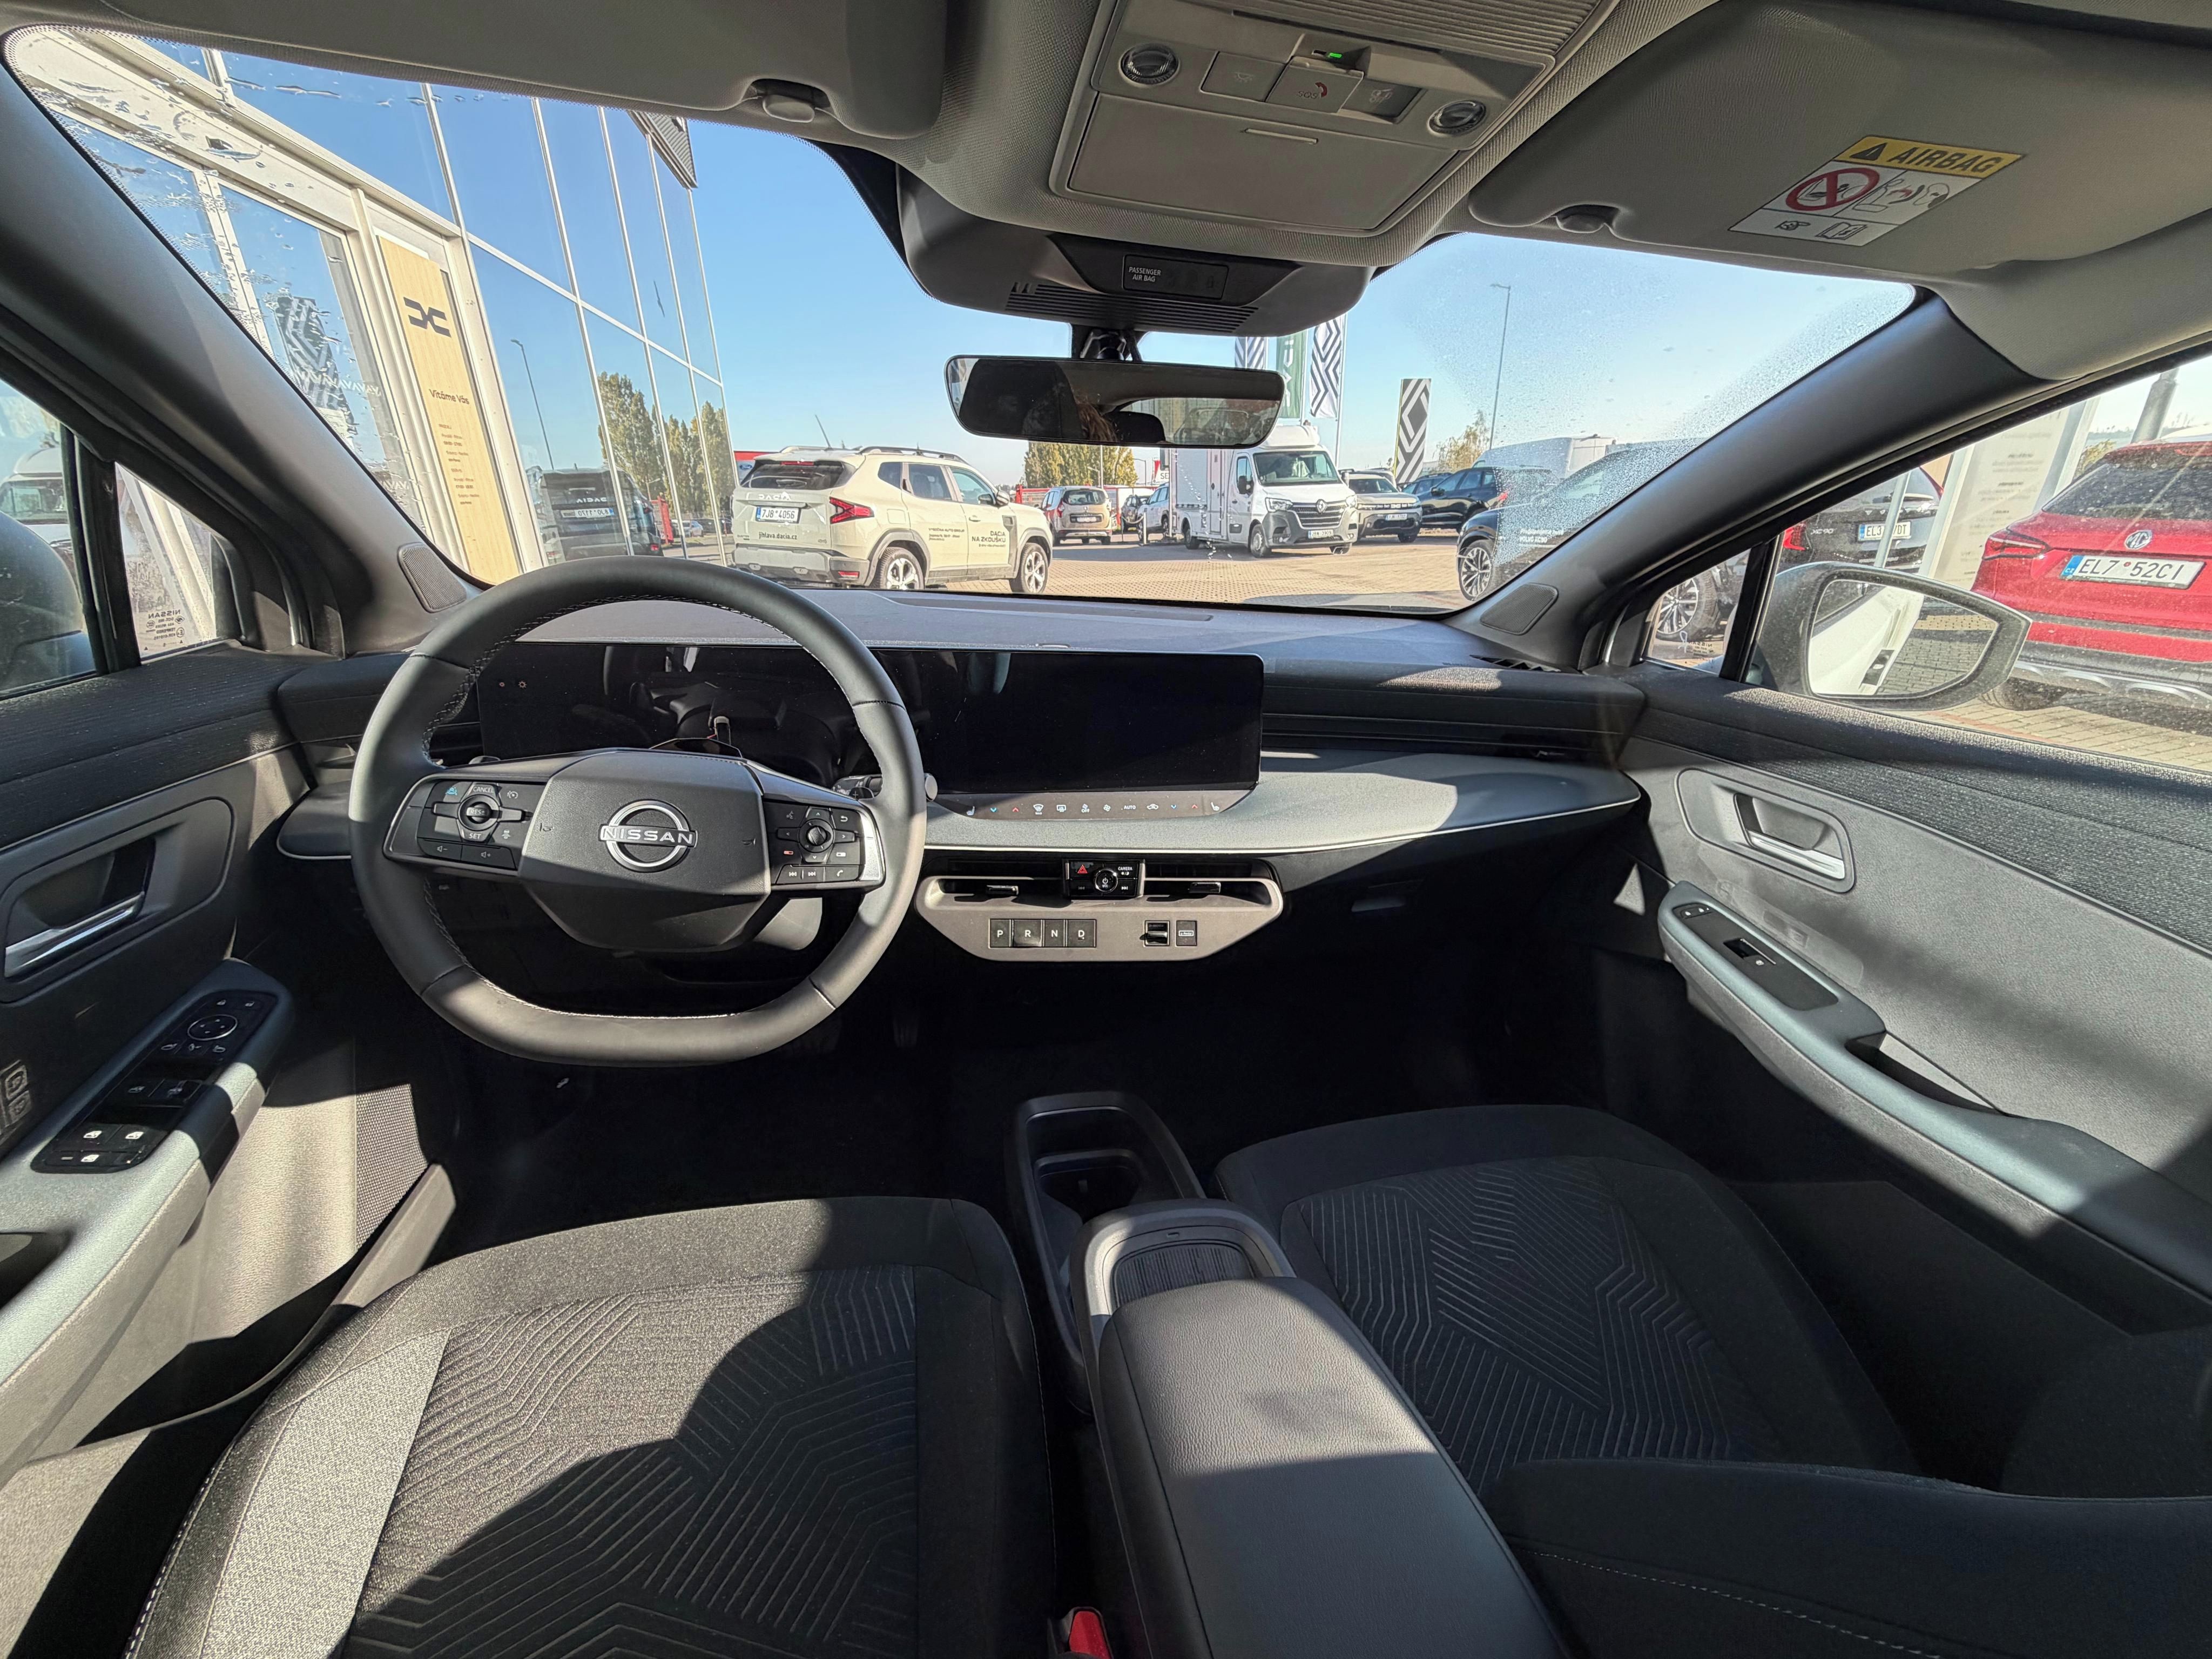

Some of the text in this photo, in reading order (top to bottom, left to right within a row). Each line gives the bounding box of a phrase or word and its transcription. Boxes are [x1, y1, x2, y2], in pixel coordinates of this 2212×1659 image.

[1297, 91, 1318, 99] SOS
[1887, 147, 2002, 173] AIRBAG
[1129, 267, 1161, 276] PASSENGER
[761, 509, 795, 519] 7J8 4056
[758, 531, 798, 540] jihlava.dacia.cz
[1866, 525, 1882, 536] EL3
[2127, 530, 2151, 549] MG
[2079, 558, 2120, 575] EL7
[603, 826, 693, 844] NISSAN
